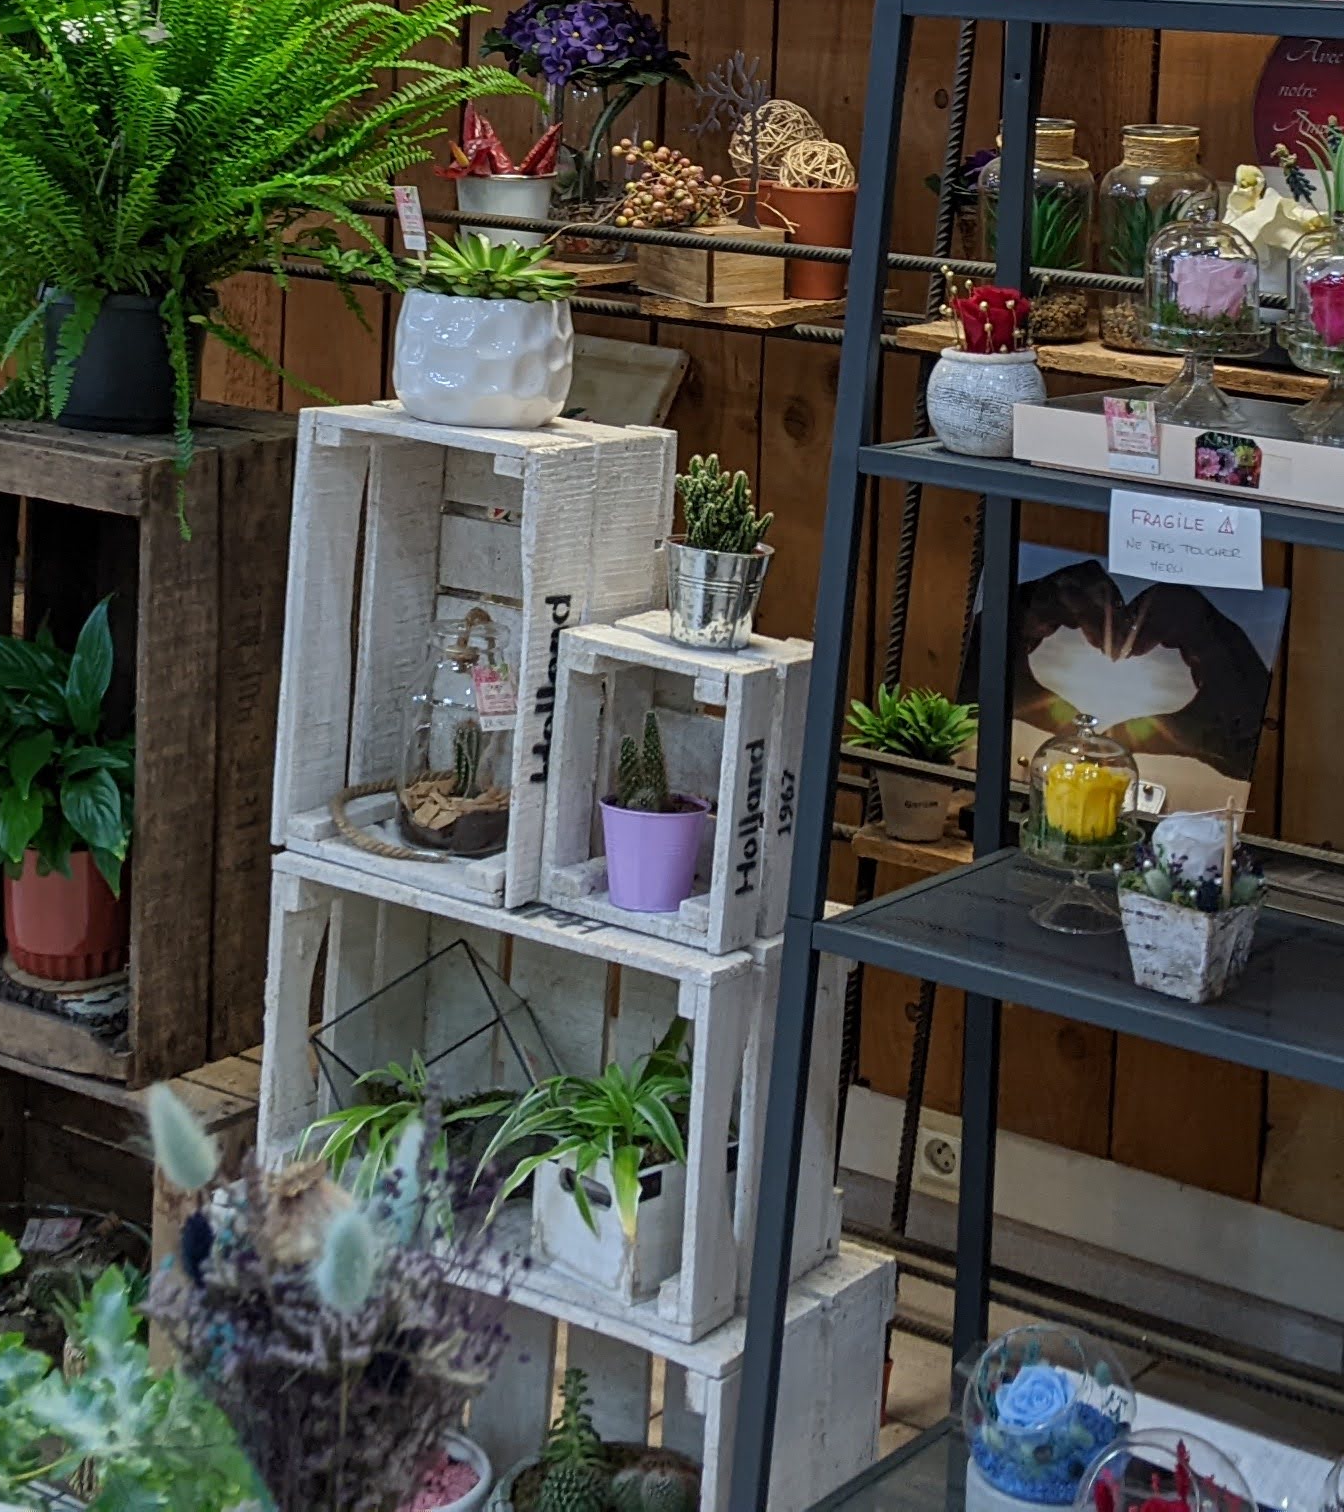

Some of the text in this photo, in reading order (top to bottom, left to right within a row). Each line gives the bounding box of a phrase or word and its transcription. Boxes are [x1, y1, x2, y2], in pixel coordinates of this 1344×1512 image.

[1286, 39, 1343, 65] Avec
[1278, 82, 1318, 98] notre
[1126, 537, 1143, 550] NE
[1179, 544, 1242, 559] TOUCHER
[777, 769, 796, 837] 1967
[735, 737, 765, 896] Holland
